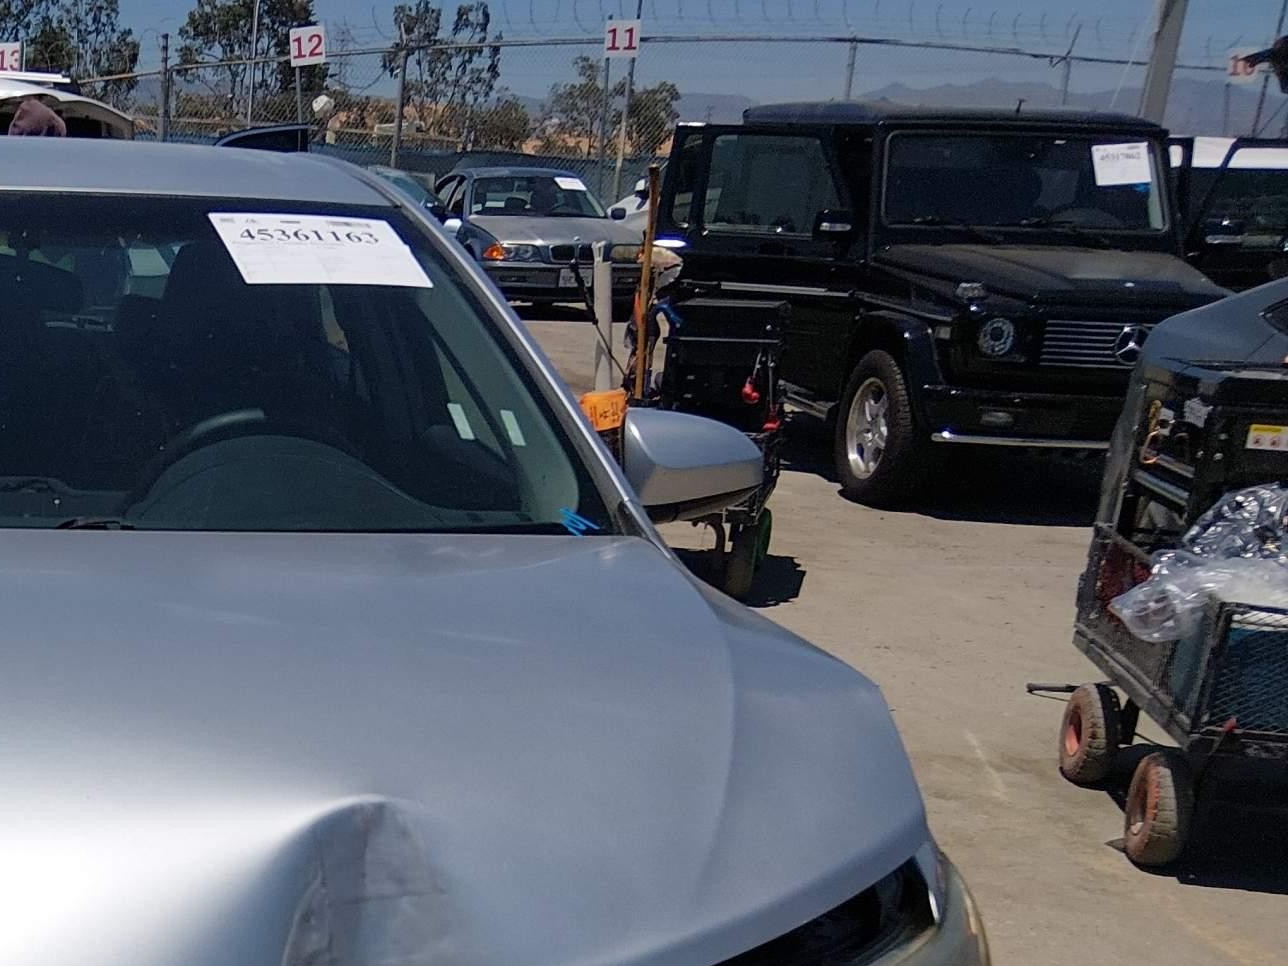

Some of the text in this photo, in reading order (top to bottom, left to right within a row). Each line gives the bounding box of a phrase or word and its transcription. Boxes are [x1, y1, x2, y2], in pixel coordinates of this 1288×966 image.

[292, 33, 323, 59] 12
[606, 27, 637, 51] 11
[240, 227, 380, 245] 45361163
